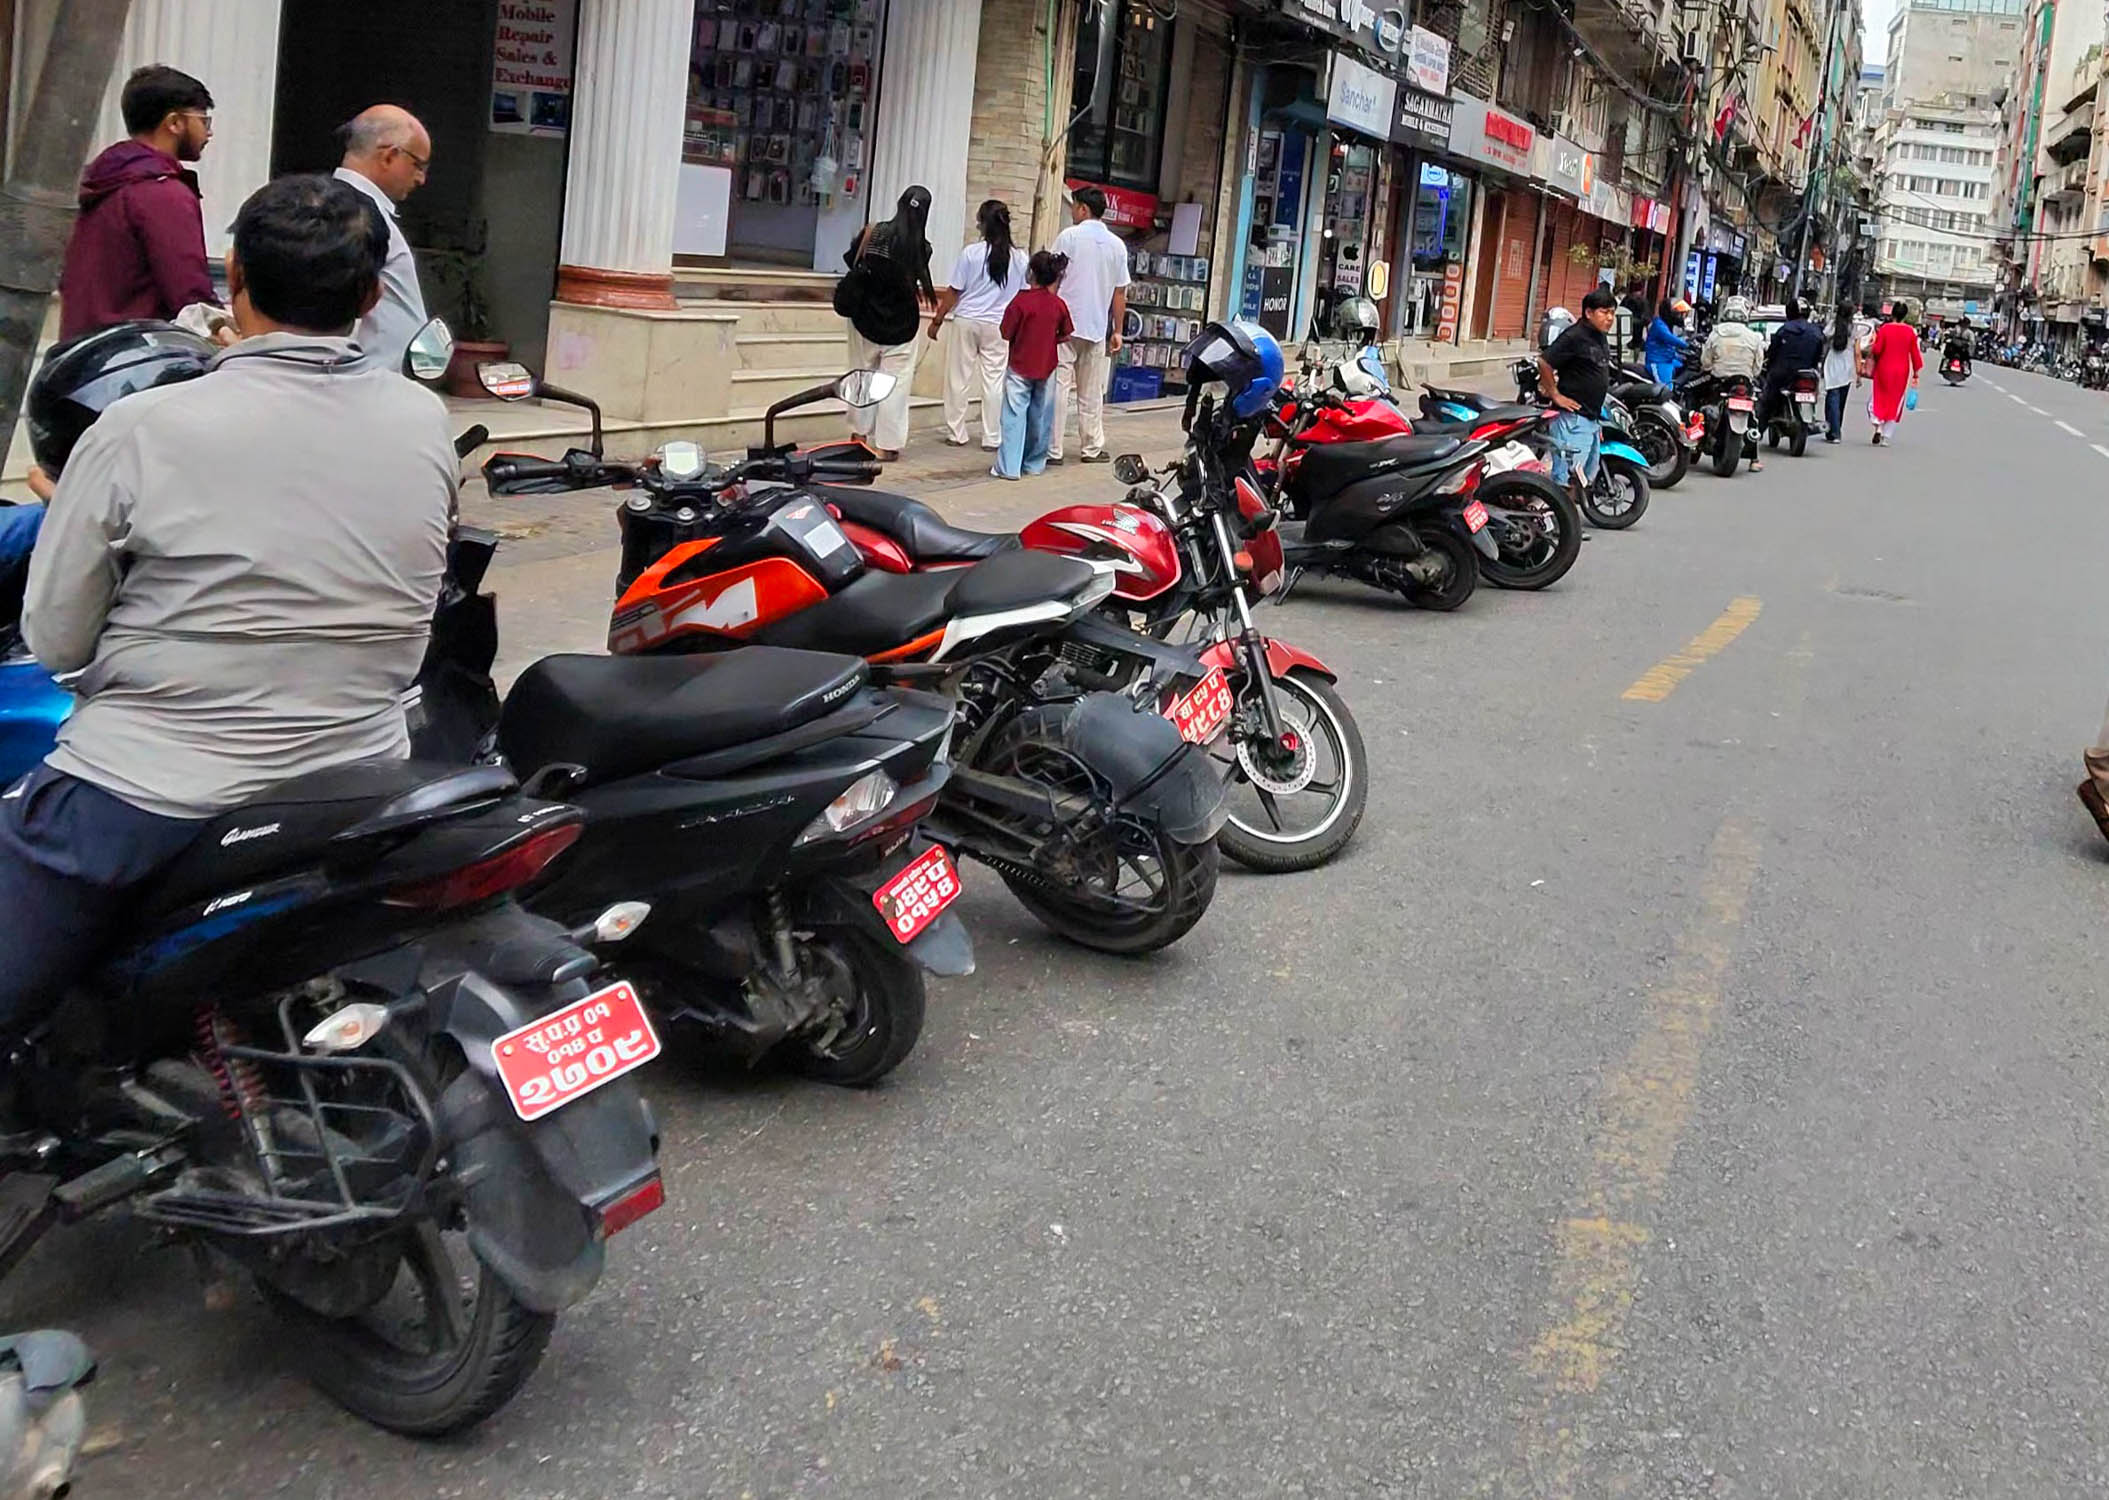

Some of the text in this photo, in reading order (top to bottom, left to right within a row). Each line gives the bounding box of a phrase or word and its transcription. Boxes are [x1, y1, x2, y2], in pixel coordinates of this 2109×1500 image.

[501, 4, 555, 22] Mobile
[498, 26, 554, 45] Repair
[496, 47, 557, 66] Sales &
[1338, 263, 1360, 272] CARE
[1337, 274, 1359, 284] SALES
[1264, 297, 1287, 312] HONOR
[822, 674, 860, 703] HONDA
[583, 1002, 610, 1025] ०१
[547, 1037, 587, 1065] ०१४
[519, 1029, 648, 1106] २७०९
